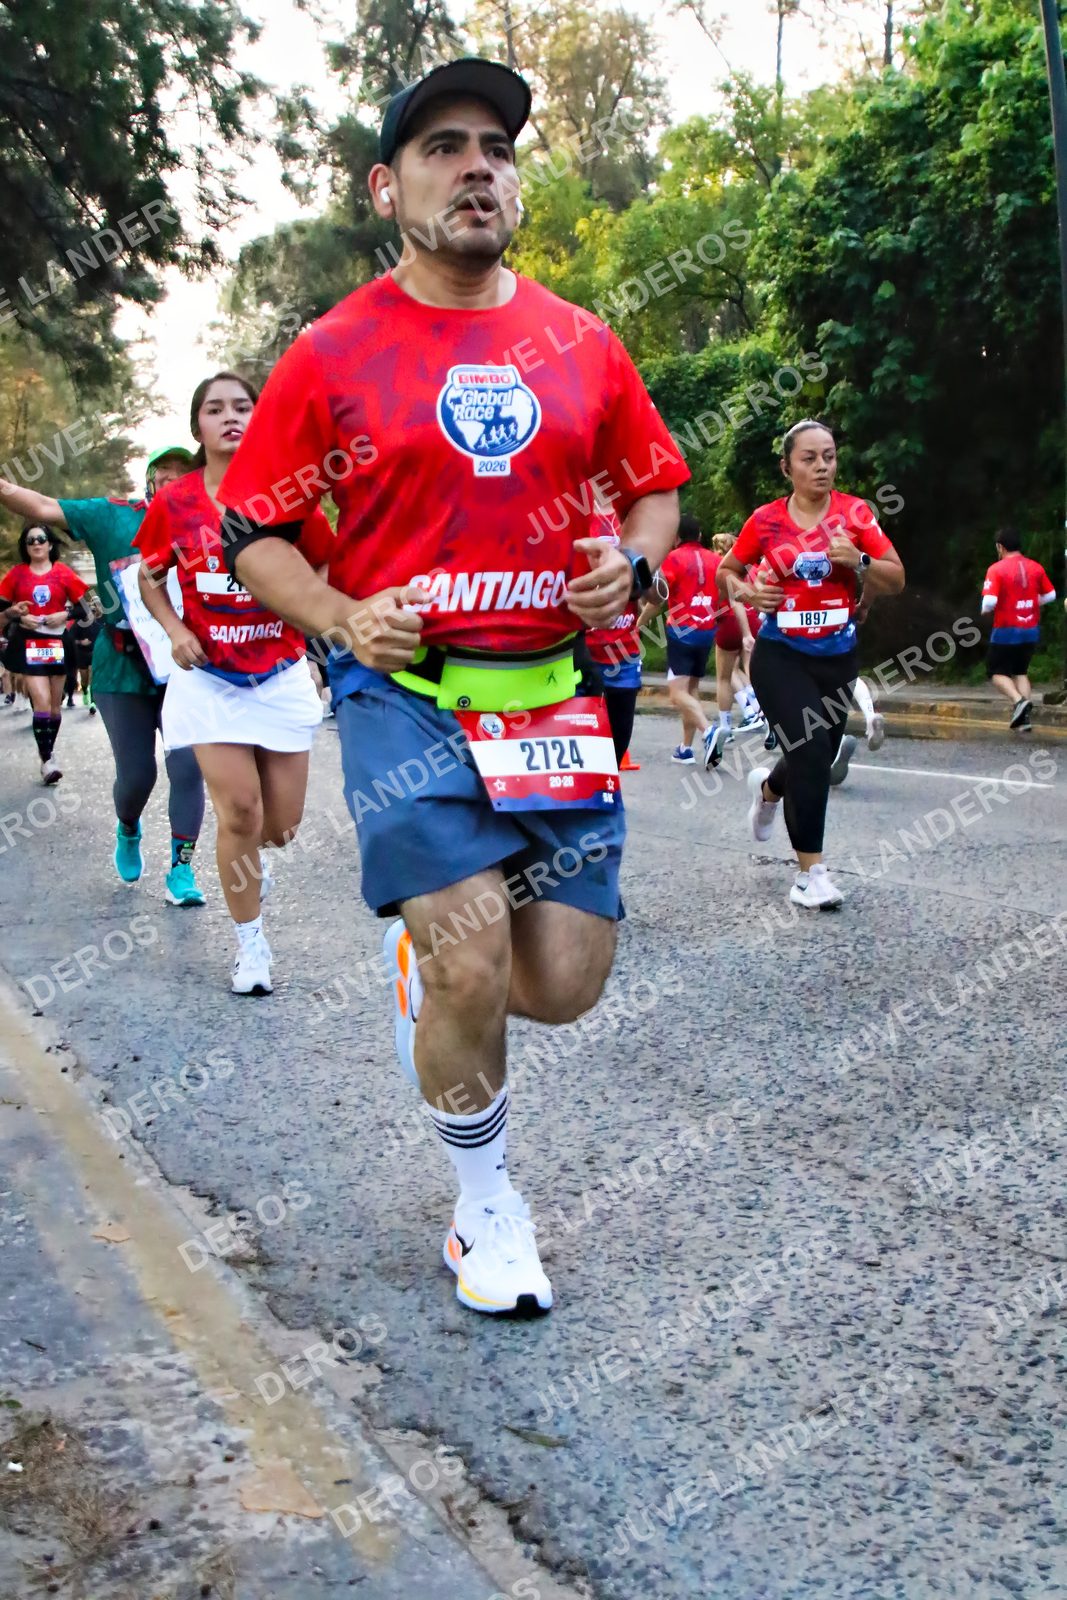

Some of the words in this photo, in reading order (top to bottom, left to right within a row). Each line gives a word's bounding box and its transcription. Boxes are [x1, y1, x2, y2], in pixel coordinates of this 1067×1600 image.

[458, 374, 511, 384] BIMBO
[461, 389, 513, 406] Global
[453, 404, 495, 421] Race
[478, 460, 507, 473] 2026
[402, 570, 569, 614] SANTIAGO
[799, 611, 828, 626] 1897
[209, 620, 284, 644] SANTIAGO
[519, 738, 584, 771] 2724
